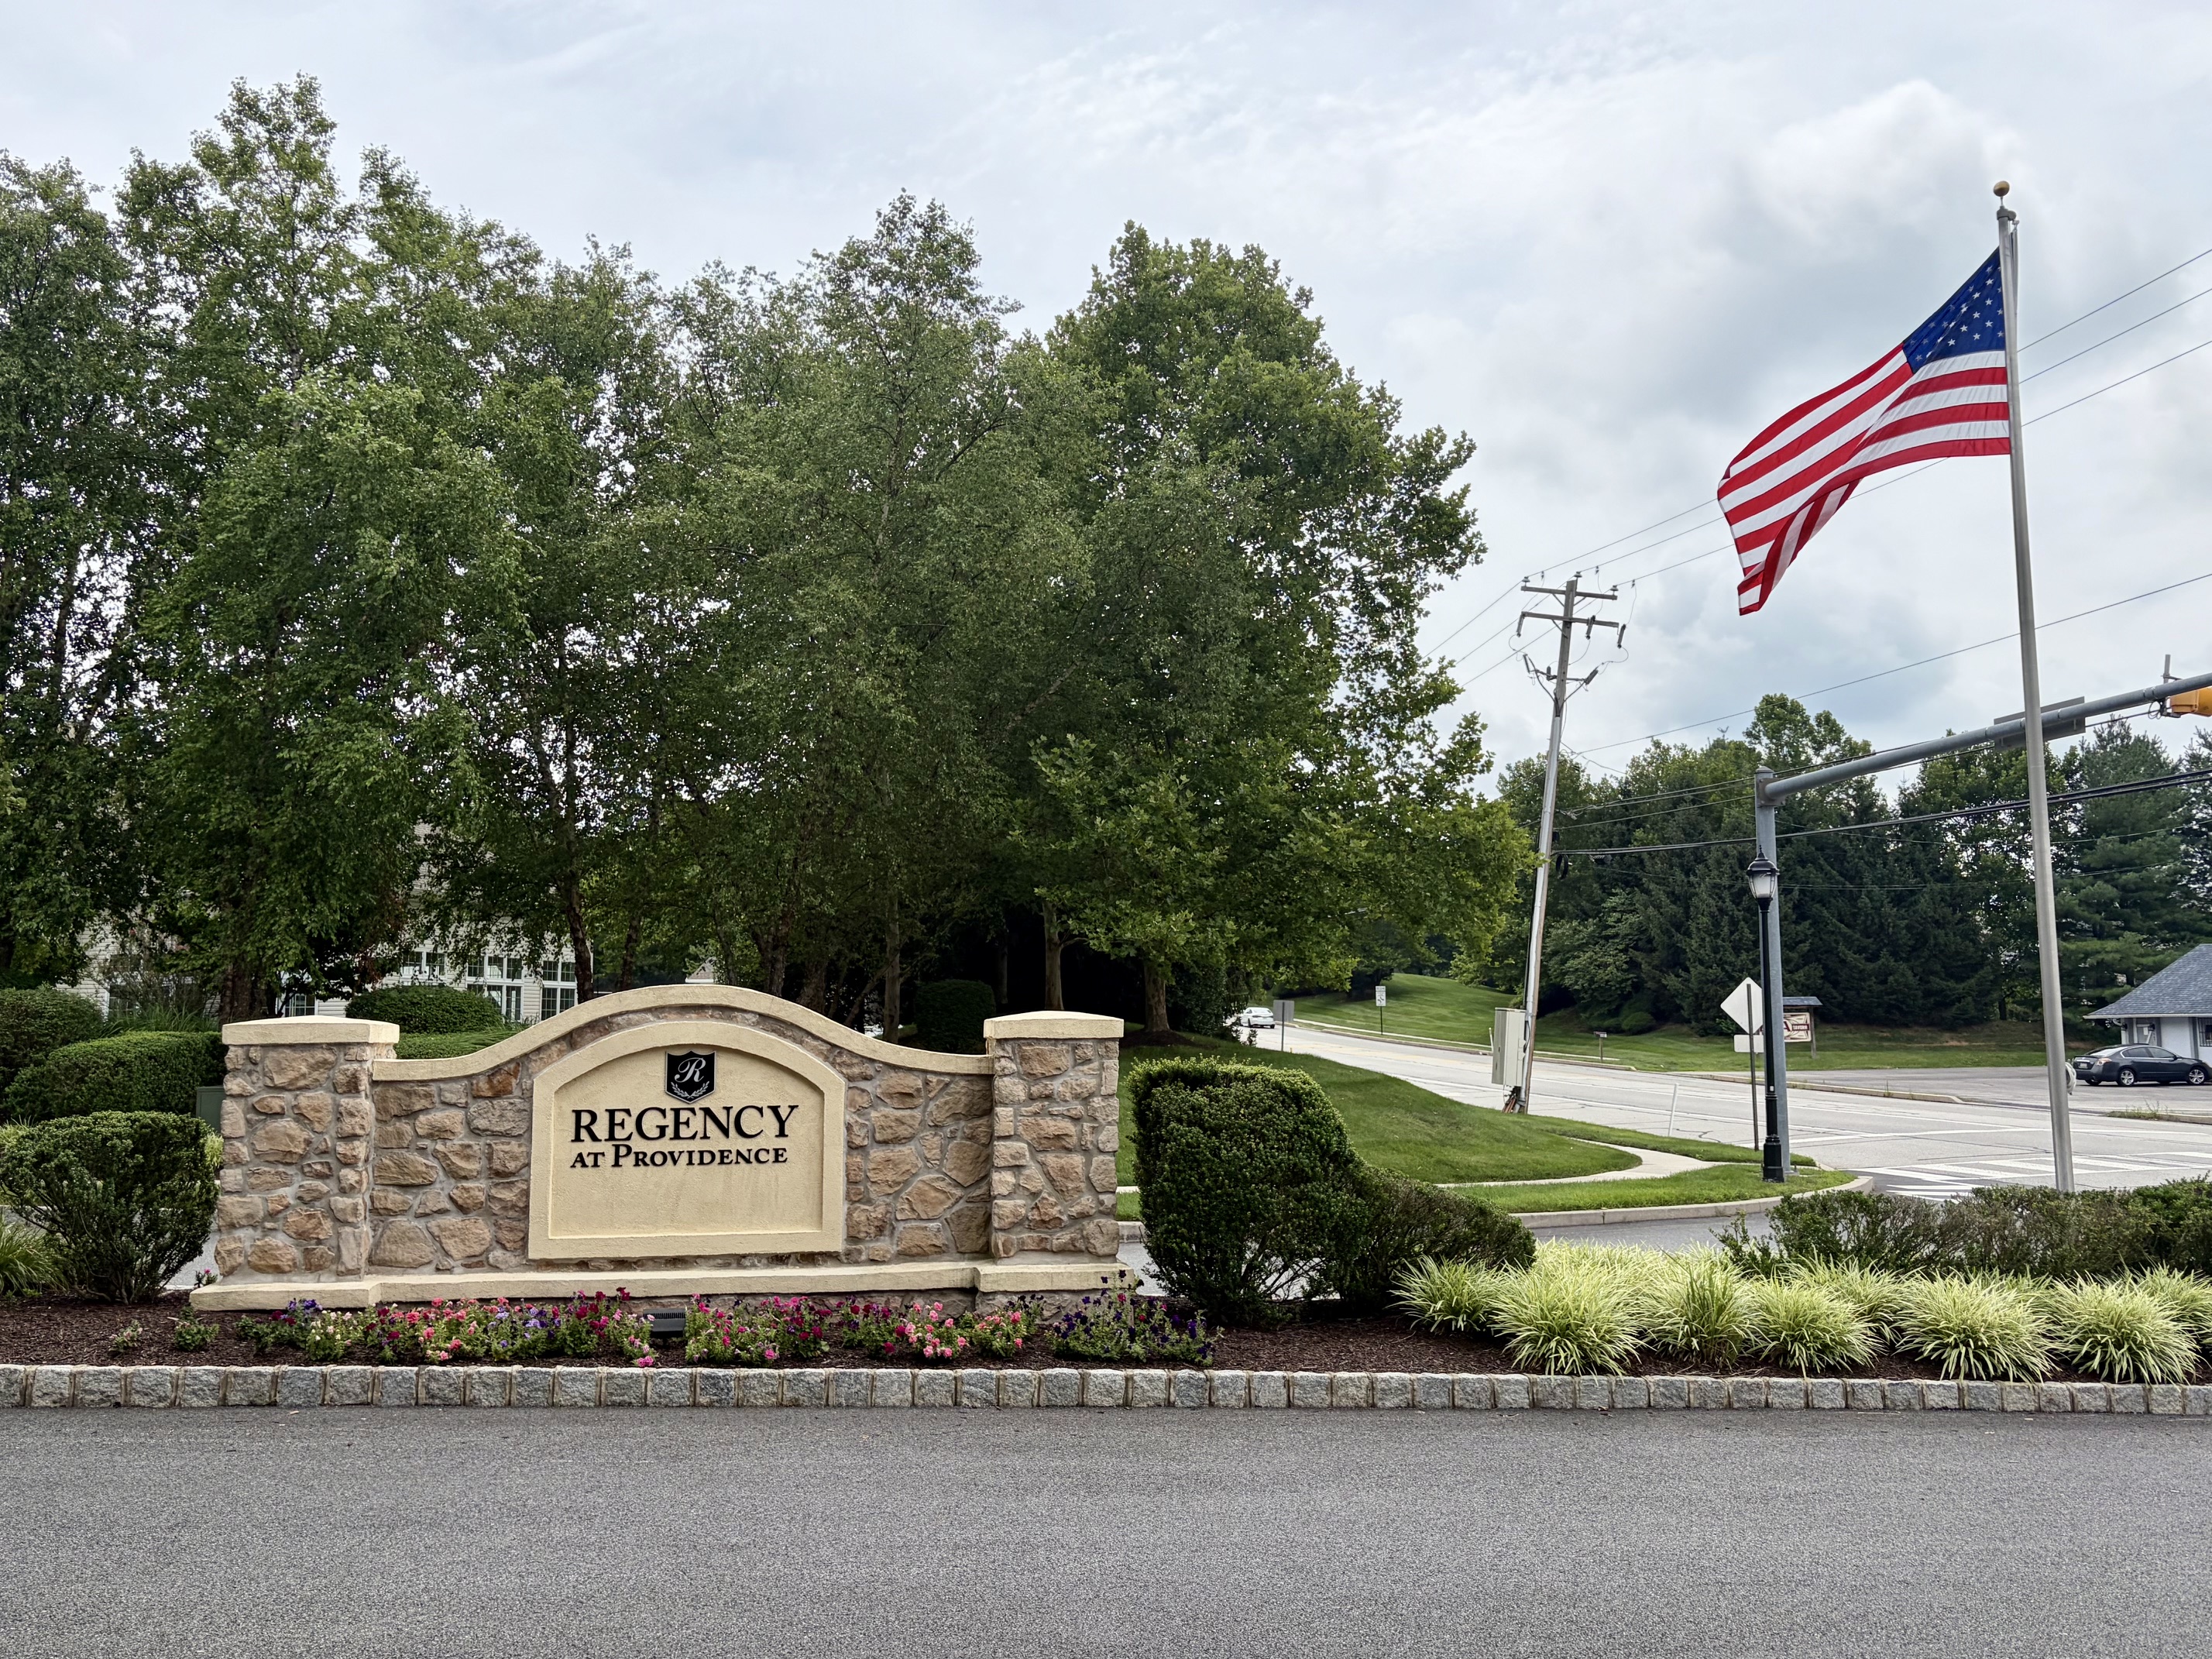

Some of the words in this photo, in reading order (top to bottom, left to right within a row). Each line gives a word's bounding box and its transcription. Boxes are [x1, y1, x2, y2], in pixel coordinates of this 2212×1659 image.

[674, 1057, 706, 1083] R
[571, 1104, 799, 1142] REGENCY
[570, 1151, 605, 1168] AT
[611, 1143, 788, 1168] PROVIDENCE
